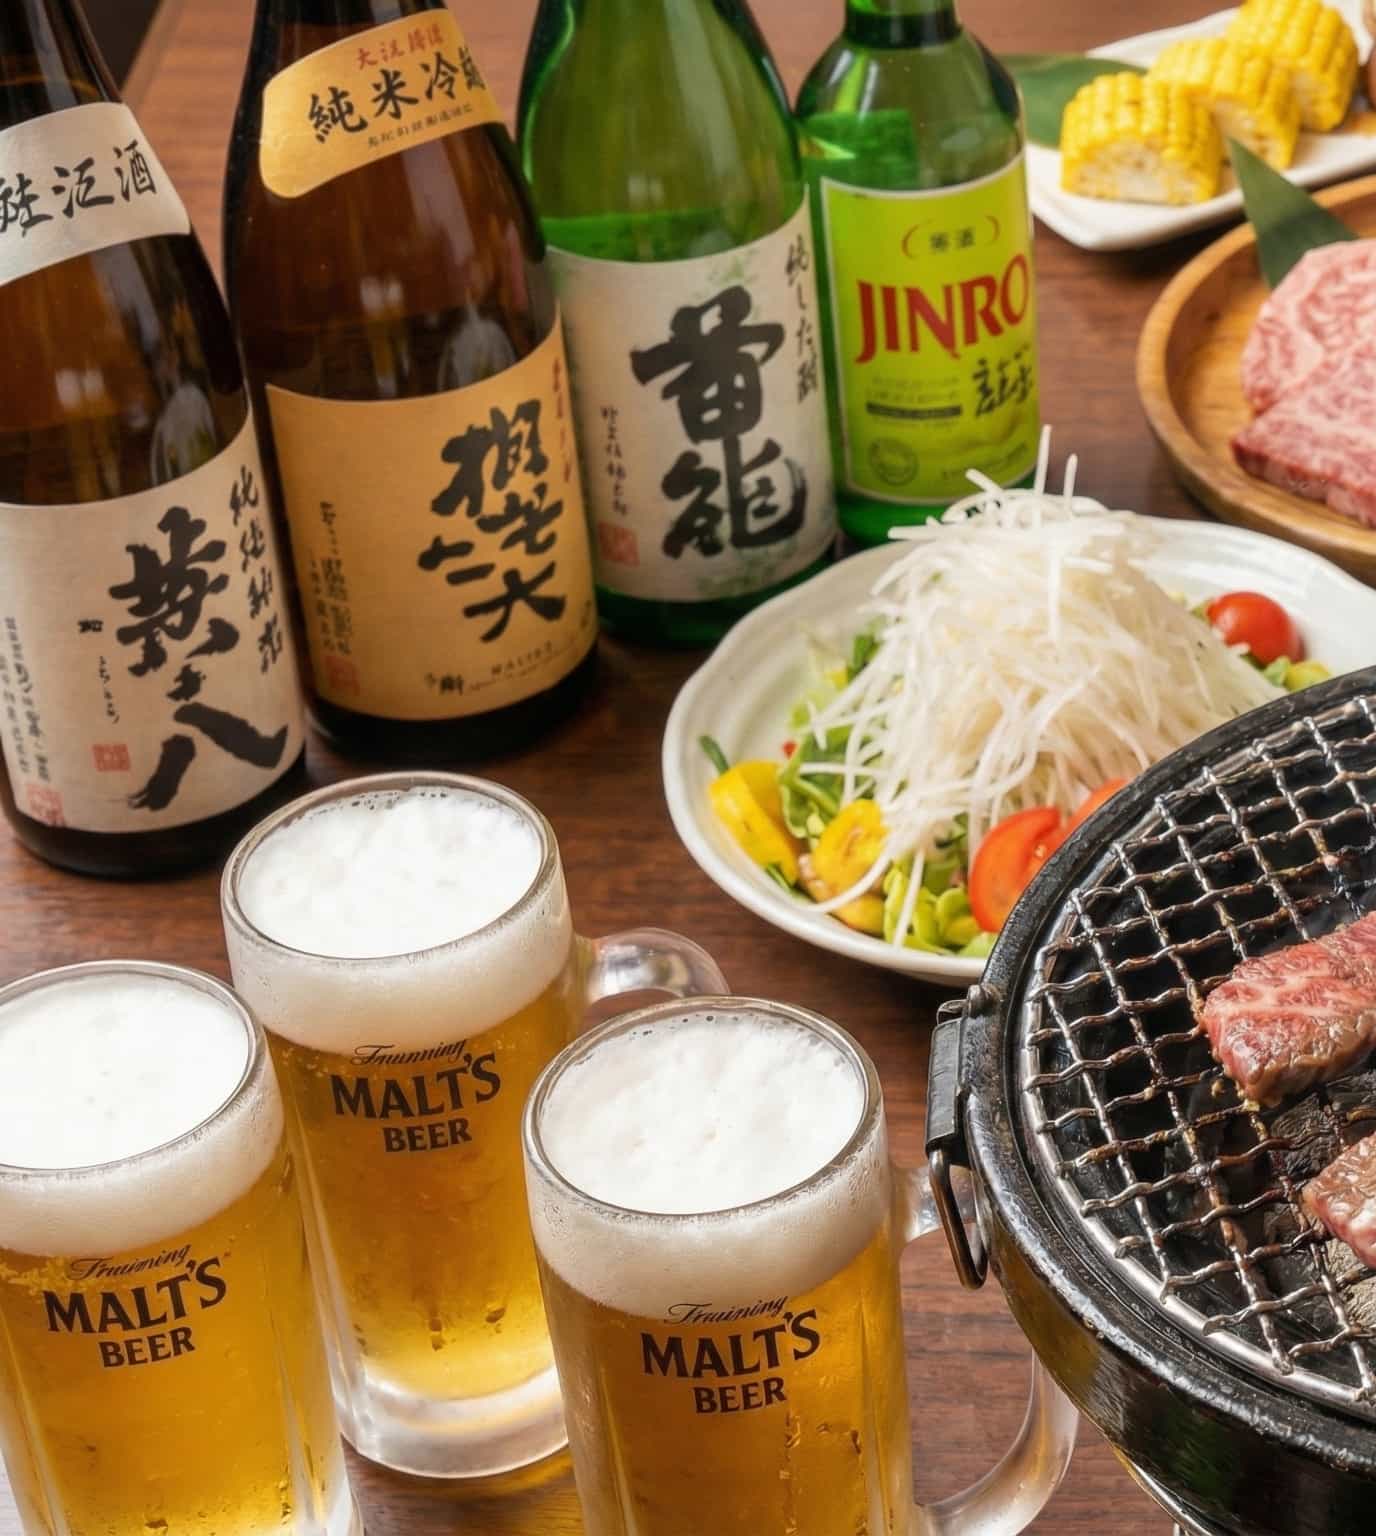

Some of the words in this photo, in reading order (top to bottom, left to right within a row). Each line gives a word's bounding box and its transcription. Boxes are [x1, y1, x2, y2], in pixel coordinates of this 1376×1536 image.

[854, 253, 1030, 364] JINRO
[330, 1052, 502, 1120] MALT'S
[382, 1117, 473, 1153] BEER
[42, 1256, 227, 1334] MALT'S
[98, 1326, 196, 1368] BEER
[640, 1309, 821, 1379] MALT'S
[693, 1376, 788, 1414] BEER
